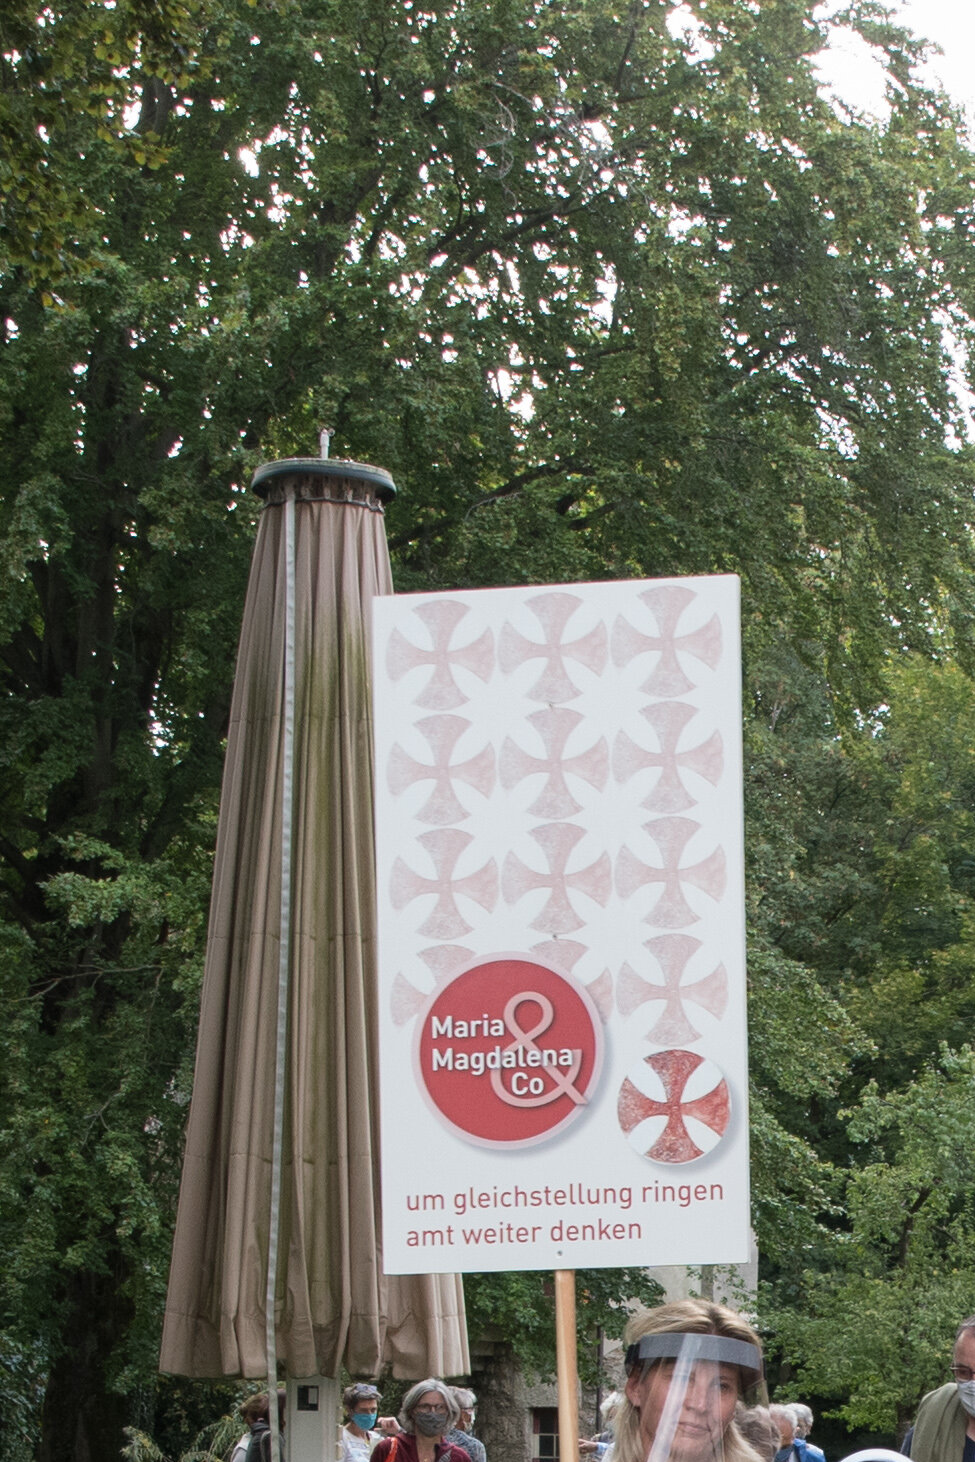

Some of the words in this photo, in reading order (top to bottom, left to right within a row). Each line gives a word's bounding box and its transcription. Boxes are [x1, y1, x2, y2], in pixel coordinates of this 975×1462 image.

[431, 1013, 505, 1040] Maria
[431, 1044, 574, 1076] Magdalena
[510, 1071, 545, 1095] Co
[406, 1193, 445, 1212] um
[453, 1183, 632, 1216] gleichstellung
[641, 1180, 724, 1208] ringen
[406, 1225, 455, 1247] amt
[461, 1221, 542, 1245] weiter
[550, 1218, 642, 1243] denken
